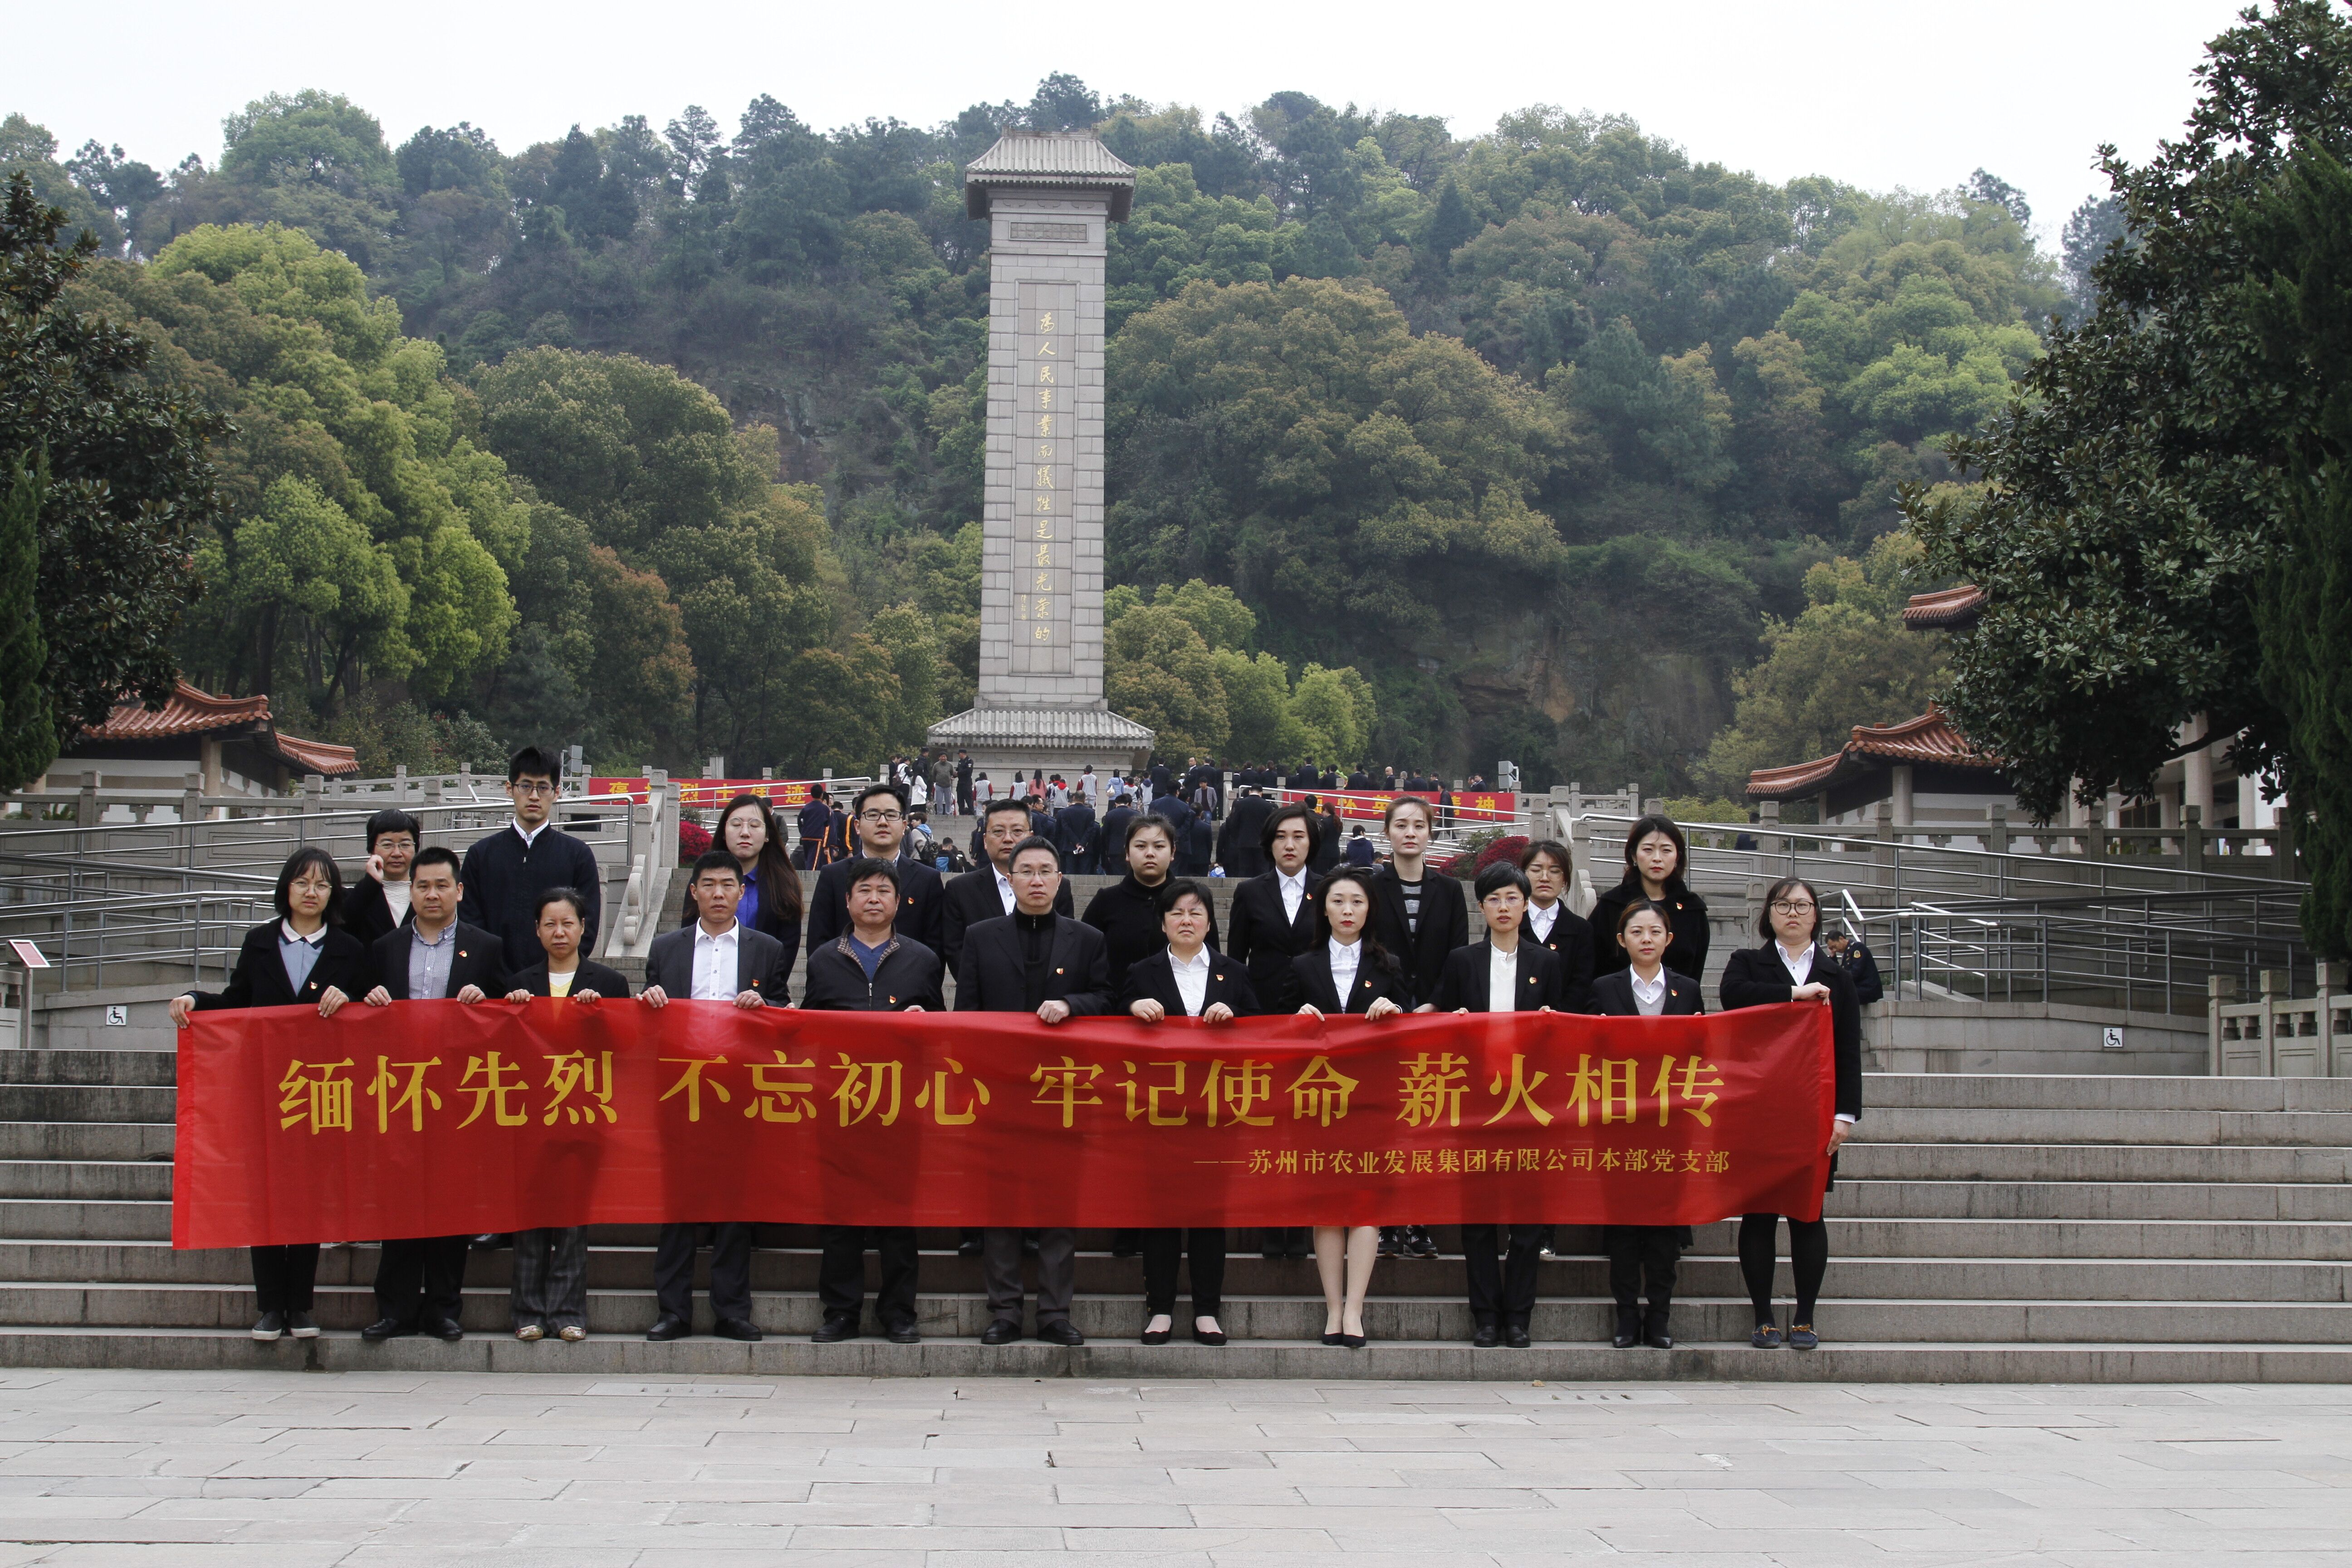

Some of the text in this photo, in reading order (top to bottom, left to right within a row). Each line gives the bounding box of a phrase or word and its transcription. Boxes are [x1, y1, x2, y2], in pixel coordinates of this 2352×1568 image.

[278, 1049, 1725, 1135] 缅怀先烈 不忘初心 牢记使命 薪火相传
